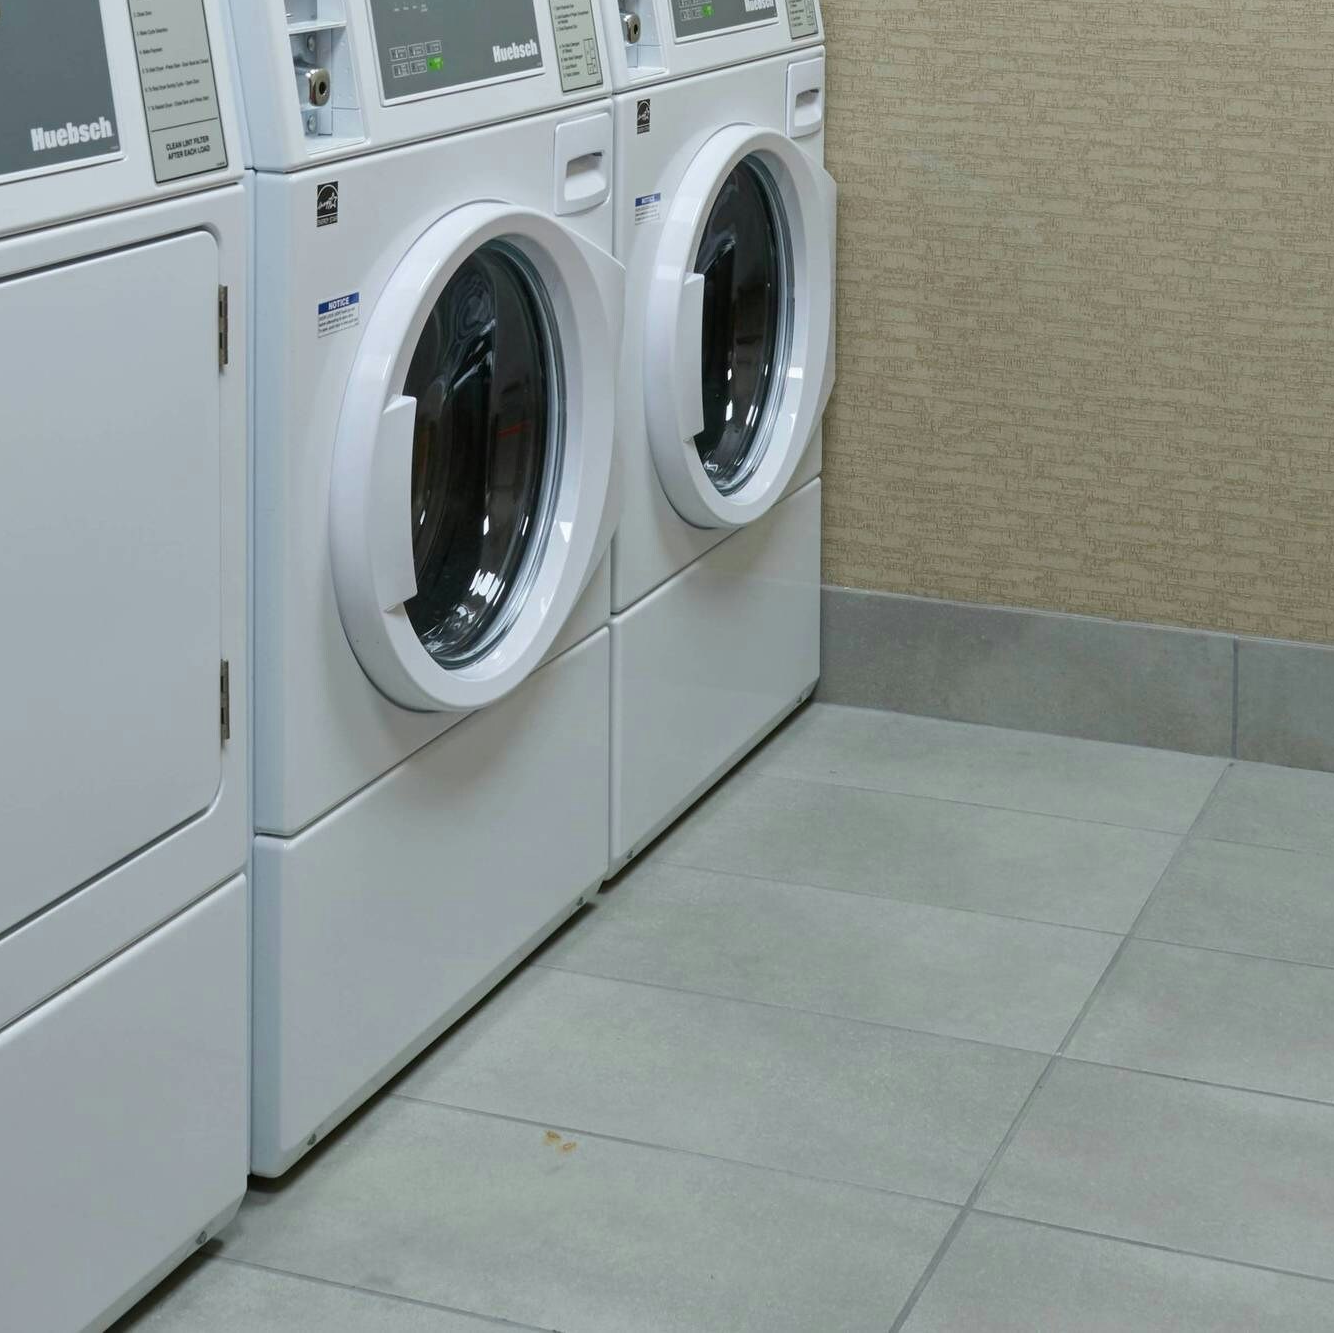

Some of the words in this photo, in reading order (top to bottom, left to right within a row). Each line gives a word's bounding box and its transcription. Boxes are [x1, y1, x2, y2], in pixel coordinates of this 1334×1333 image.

[493, 39, 538, 63] Huebsch
[31, 116, 112, 151] Huebsch
[166, 142, 182, 151] CLEAN
[183, 139, 193, 148] LINT
[193, 136, 209, 144] FILTER
[168, 151, 183, 159] AFTER
[185, 148, 197, 157] EACH
[198, 145, 210, 153] LOAD
[329, 297, 349, 310] NOTICE
